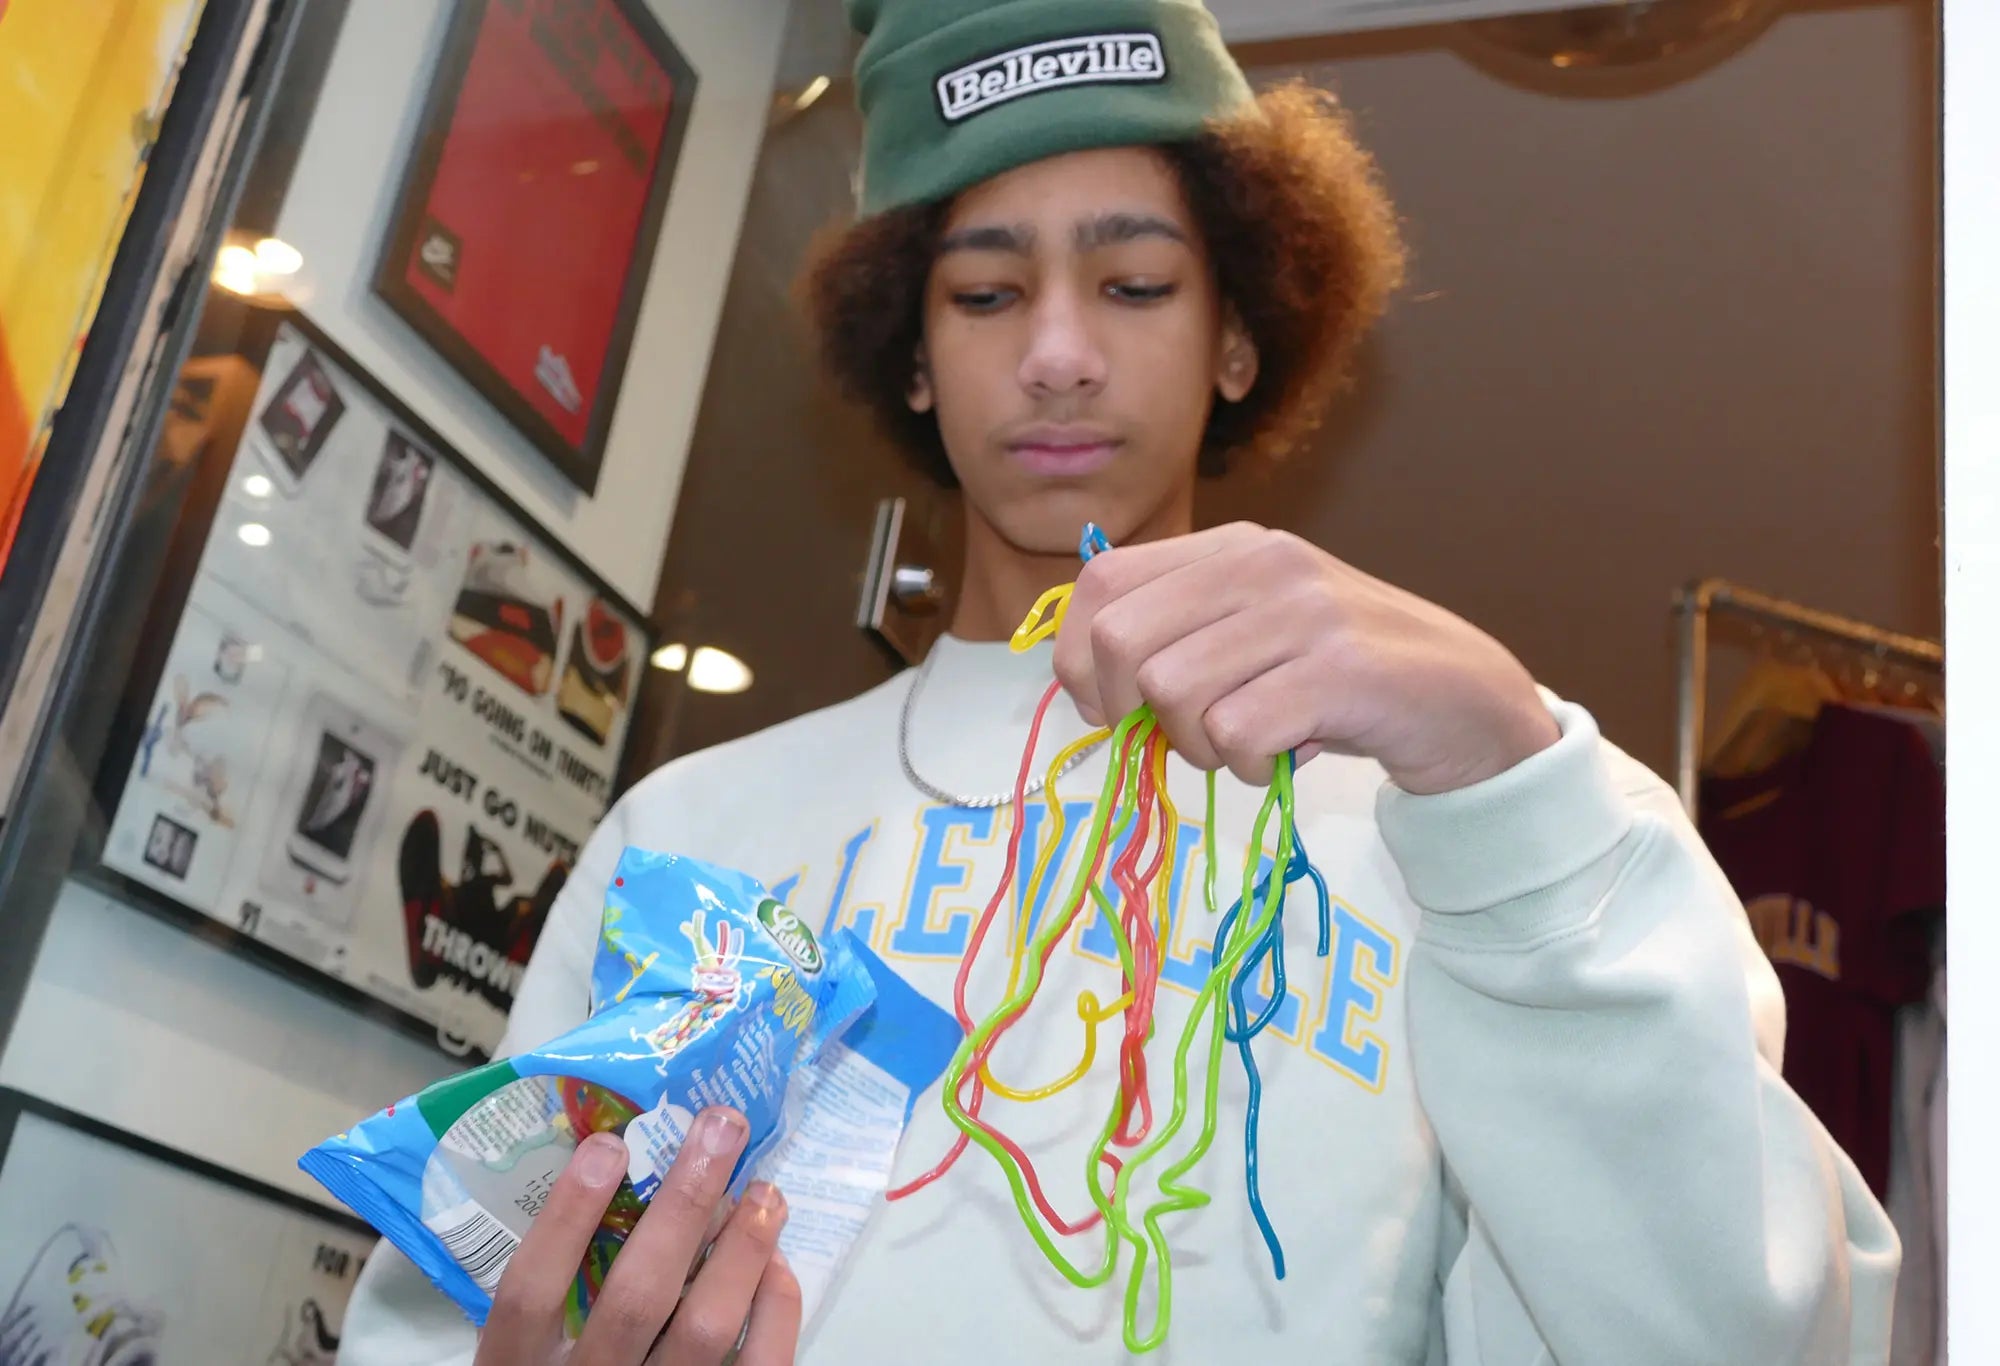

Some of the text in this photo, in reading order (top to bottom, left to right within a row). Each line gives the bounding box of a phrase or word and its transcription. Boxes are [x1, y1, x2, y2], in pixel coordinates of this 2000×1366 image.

[949, 41, 1155, 109] Belleville
[472, 687, 526, 742] GOING
[530, 728, 553, 761] ON
[418, 749, 477, 803] JUST
[483, 788, 518, 827] GO
[767, 797, 1402, 1096] LEVILLE
